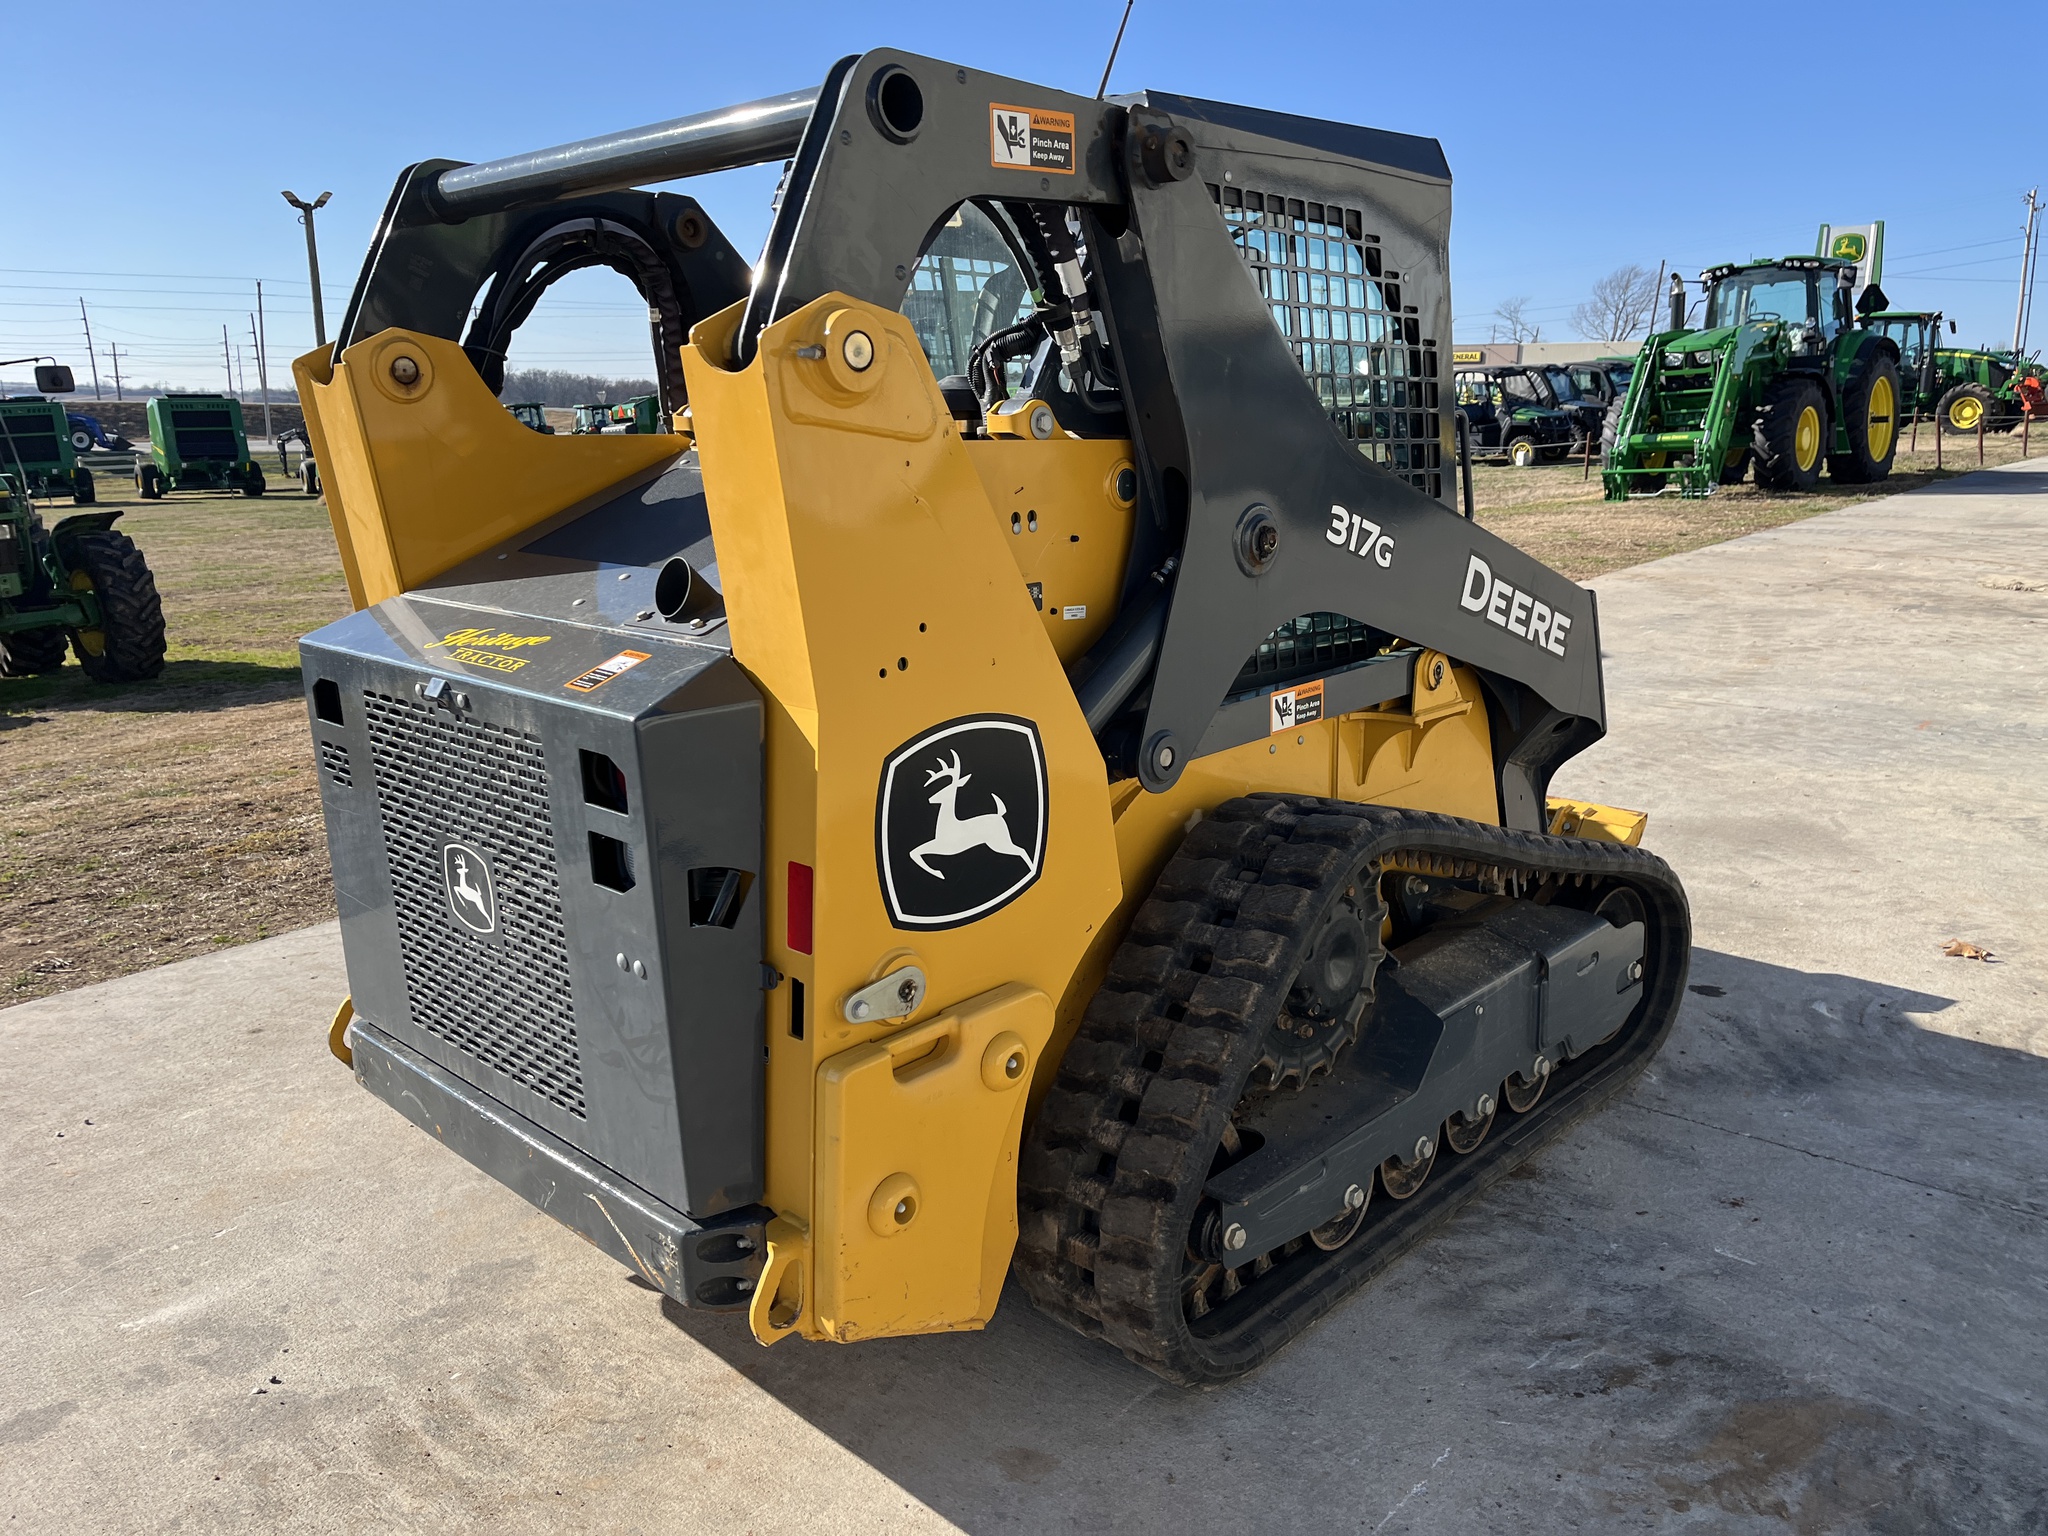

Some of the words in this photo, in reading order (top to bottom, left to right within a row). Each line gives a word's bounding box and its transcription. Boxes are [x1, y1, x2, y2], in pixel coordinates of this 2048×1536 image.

[1039, 116, 1070, 128] WARNING
[1032, 137, 1053, 148] Pinch
[1053, 140, 1070, 150] Area
[1032, 150, 1048, 161] Keep
[1048, 152, 1065, 163] Away
[1326, 505, 1395, 567] 317G
[1461, 555, 1571, 656] DEERE
[424, 628, 552, 650] Heritage
[450, 649, 525, 670] TRACTOR
[1297, 703, 1309, 711] Pinch
[1310, 700, 1320, 708] Area
